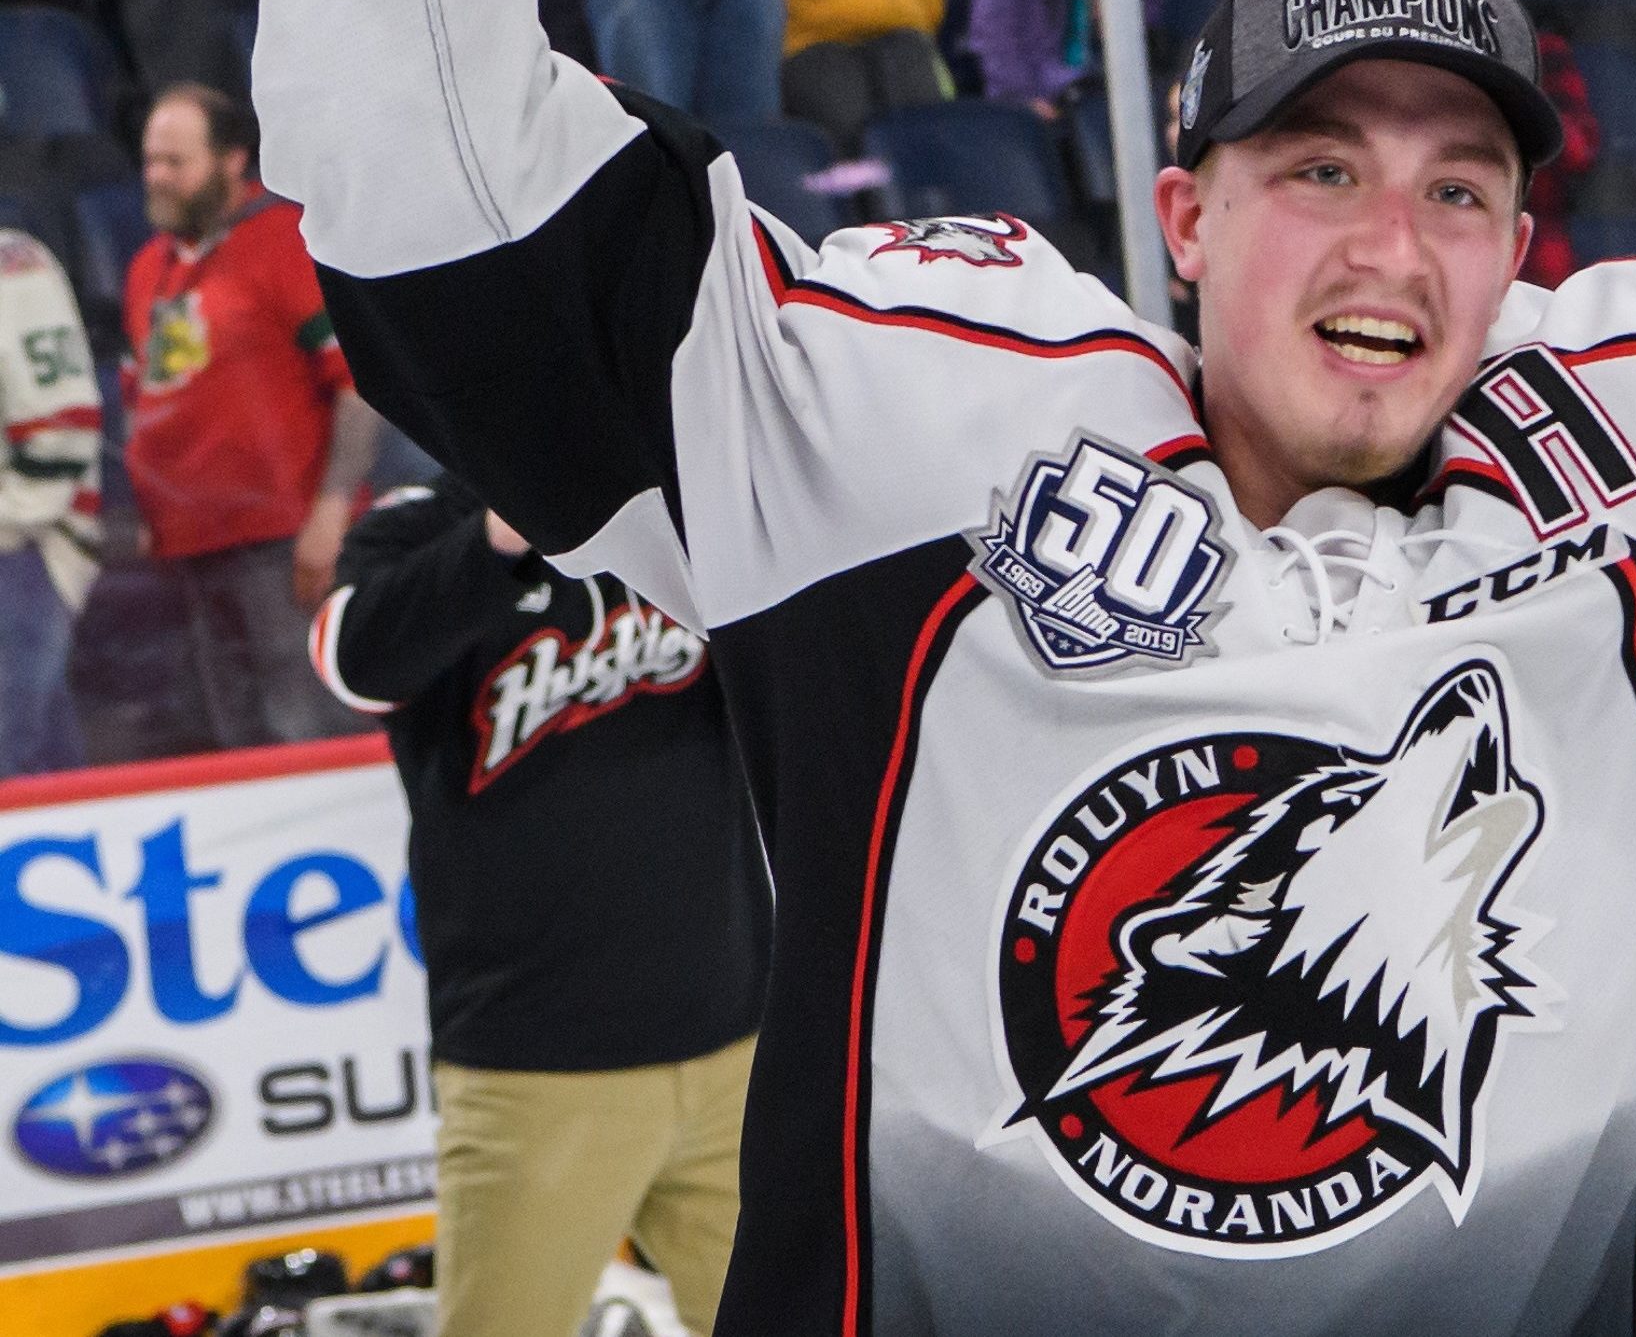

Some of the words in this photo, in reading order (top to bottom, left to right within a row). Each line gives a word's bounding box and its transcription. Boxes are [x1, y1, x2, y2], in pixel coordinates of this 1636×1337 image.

[1311, 28, 1366, 49] COUPE
[1370, 26, 1394, 38] DU
[996, 556, 1046, 601] 1969
[1031, 442, 1213, 615] 50
[1420, 523, 1608, 624] CCM
[1123, 623, 1176, 651] 2019
[484, 610, 705, 774] Huskies
[1017, 743, 1222, 937] ROUYN
[0, 815, 428, 1050] Ste
[257, 1048, 437, 1137] SU
[1077, 1130, 1412, 1238] NORANDA
